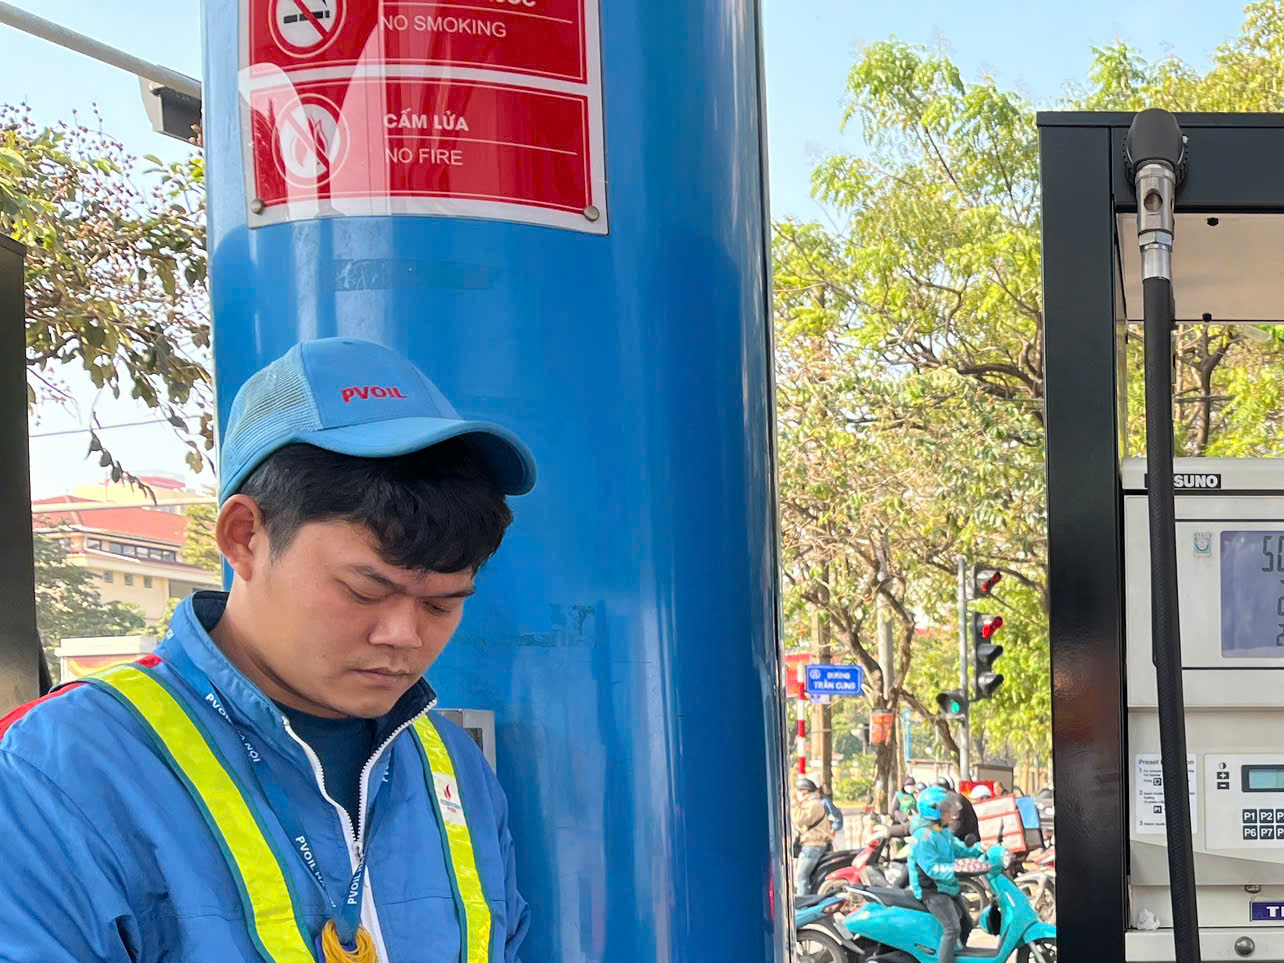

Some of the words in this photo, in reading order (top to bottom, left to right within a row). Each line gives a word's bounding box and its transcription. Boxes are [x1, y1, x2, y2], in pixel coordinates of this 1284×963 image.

[380, 15, 408, 31] NO
[413, 15, 507, 38] SMOKING
[384, 107, 428, 130] CẤM
[433, 110, 470, 131] LỬA
[385, 148, 413, 164] NO
[419, 149, 464, 166] FIRE
[340, 386, 408, 405] PVOIL
[1173, 475, 1218, 488] SUNO
[205, 692, 232, 724] PVO
[1244, 812, 1256, 821] P1
[1260, 812, 1272, 821] P2
[1244, 828, 1257, 837] P6
[1261, 828, 1273, 837] P7
[296, 835, 315, 875] PVOIL
[347, 871, 362, 905] PVOIL
